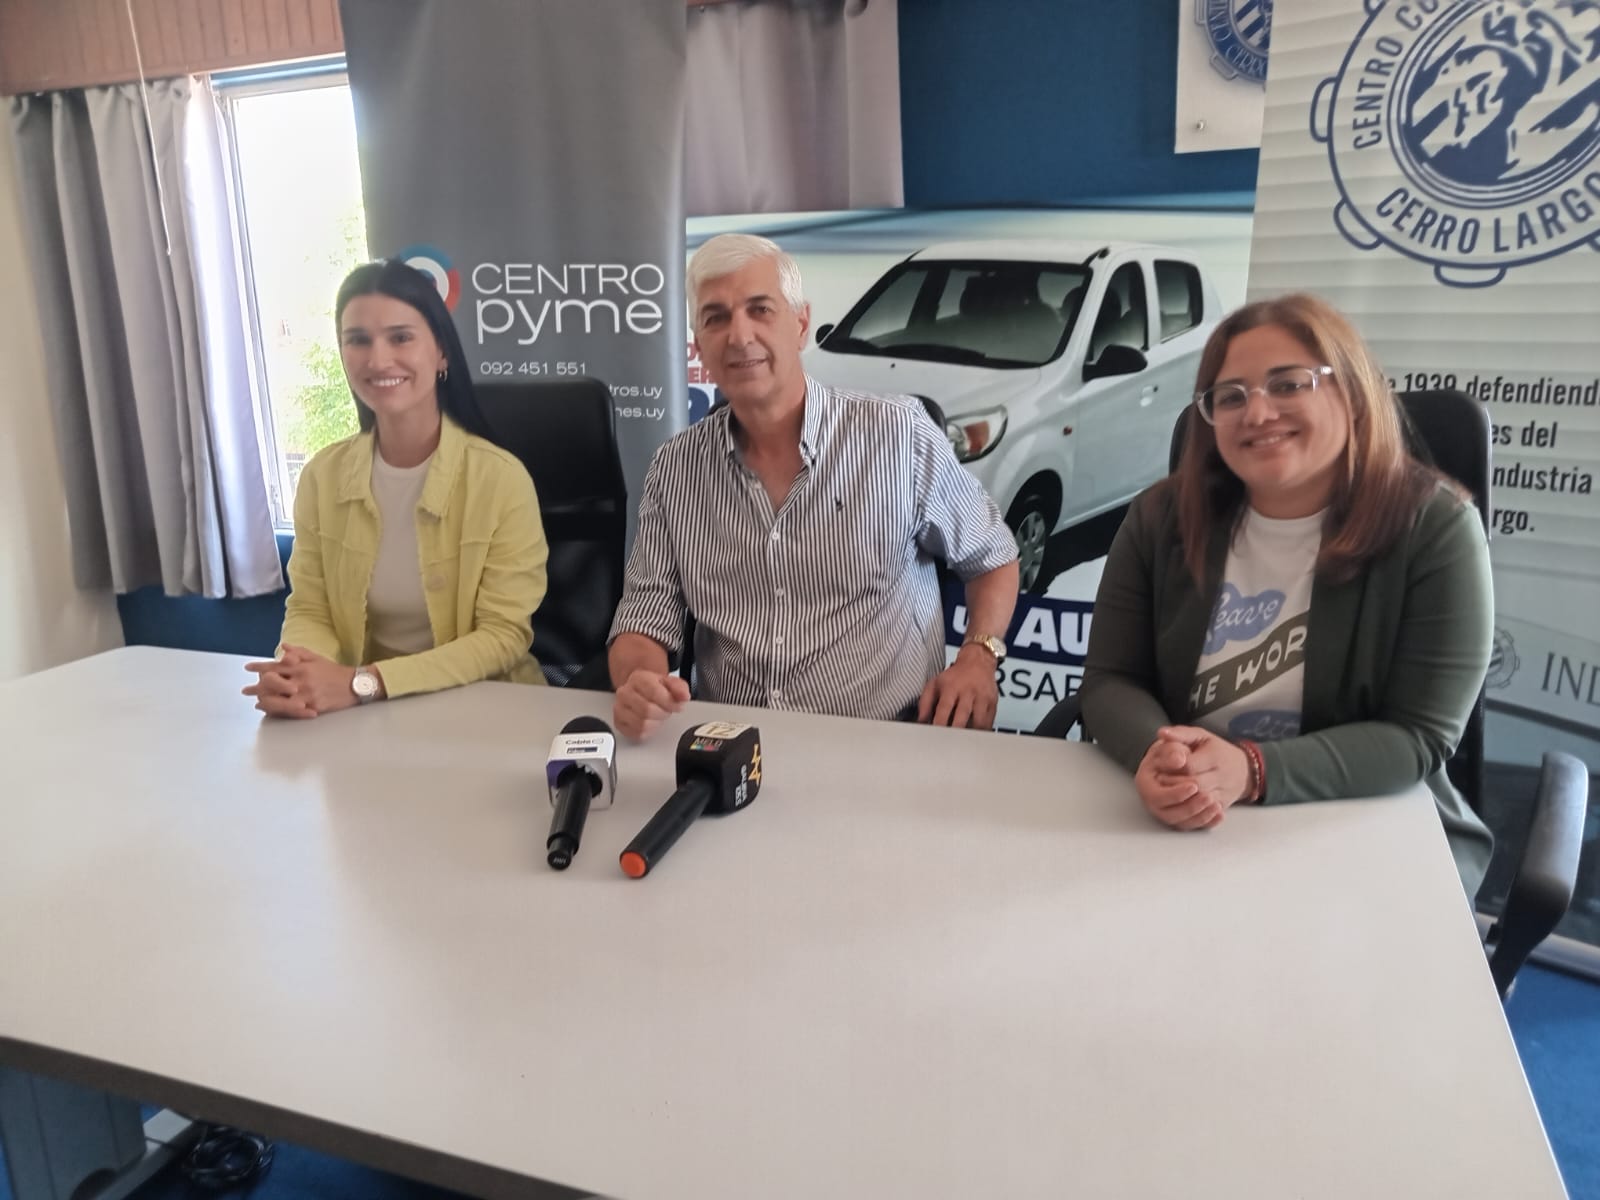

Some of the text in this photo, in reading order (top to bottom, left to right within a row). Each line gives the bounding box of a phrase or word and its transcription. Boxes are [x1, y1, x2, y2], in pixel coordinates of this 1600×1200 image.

[1353, 36, 1403, 150] CENTRO
[1376, 187, 1480, 254] CERRO
[472, 262, 665, 296] CENTRO
[476, 298, 663, 345] pyme
[480, 361, 587, 376] 092 451 551
[1466, 374, 1600, 406] defendiend
[1521, 420, 1558, 448] del
[1012, 606, 1094, 656] AU
